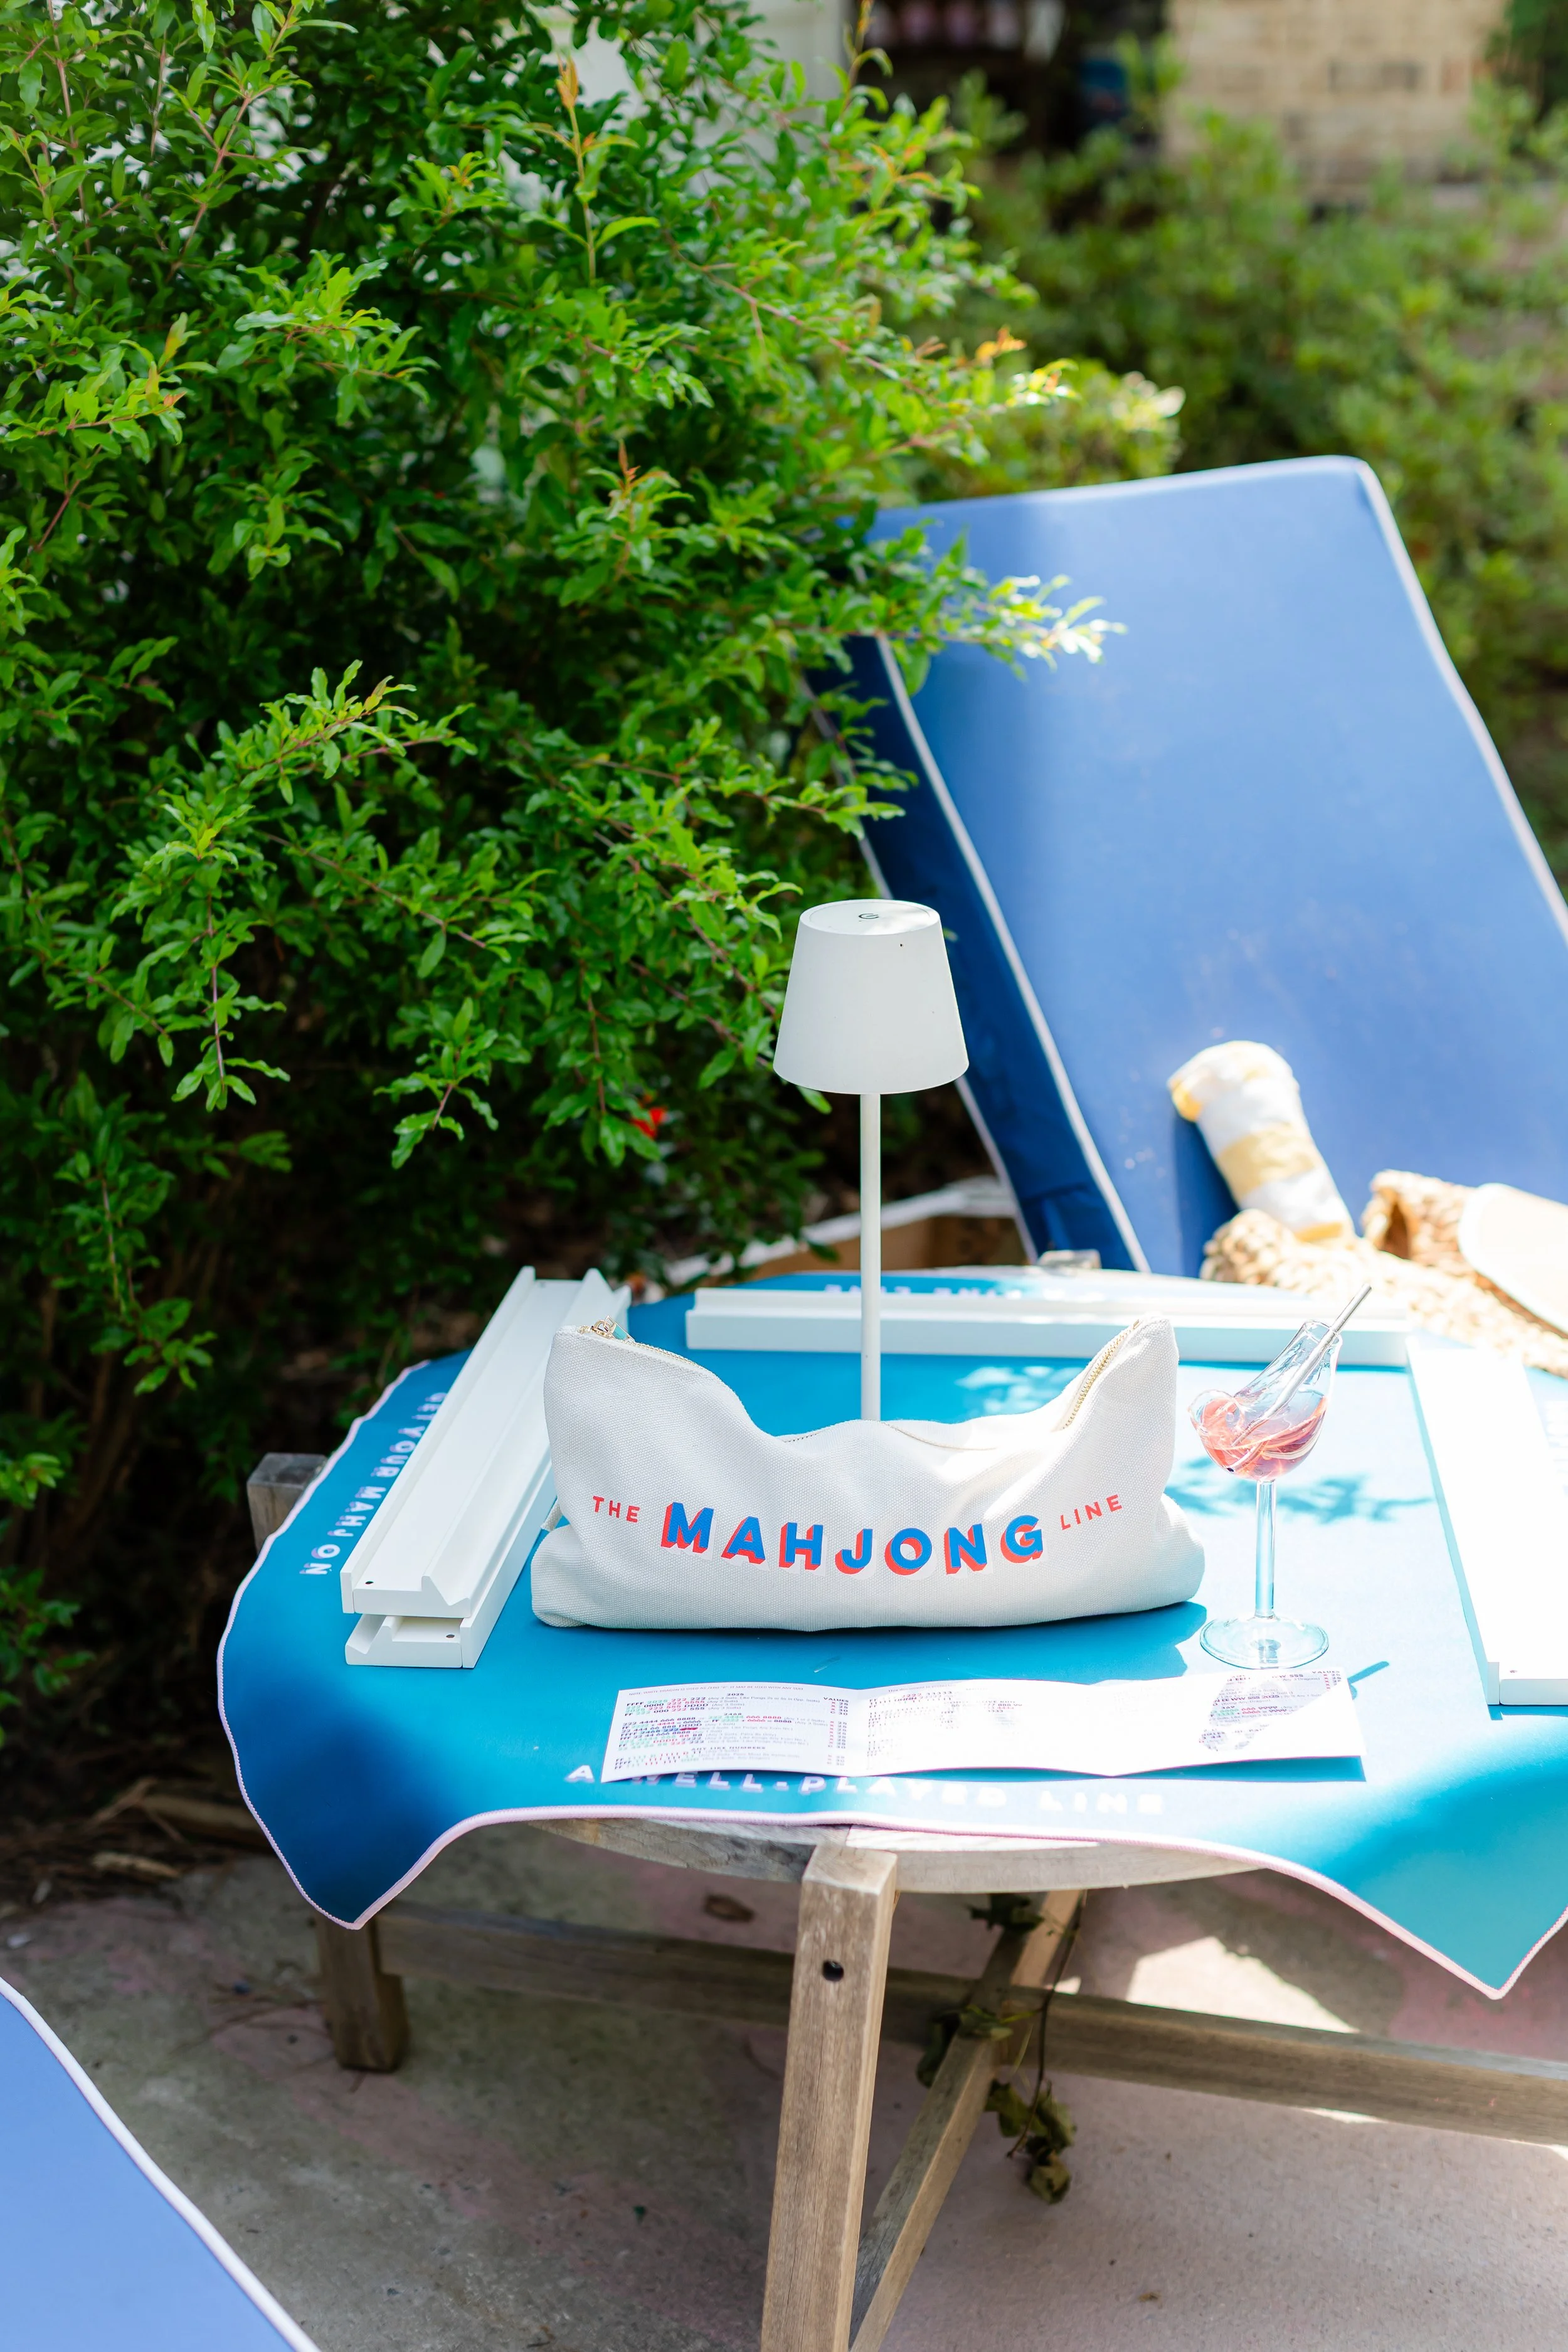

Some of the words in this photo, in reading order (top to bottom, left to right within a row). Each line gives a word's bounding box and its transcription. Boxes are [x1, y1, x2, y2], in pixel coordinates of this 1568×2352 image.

[370, 1426, 426, 1478] YOUR
[593, 1495, 640, 1523] THE
[660, 1502, 1045, 1576] MAHJONG
[1060, 1493, 1123, 1530] LINE
[564, 1765, 595, 1783] A
